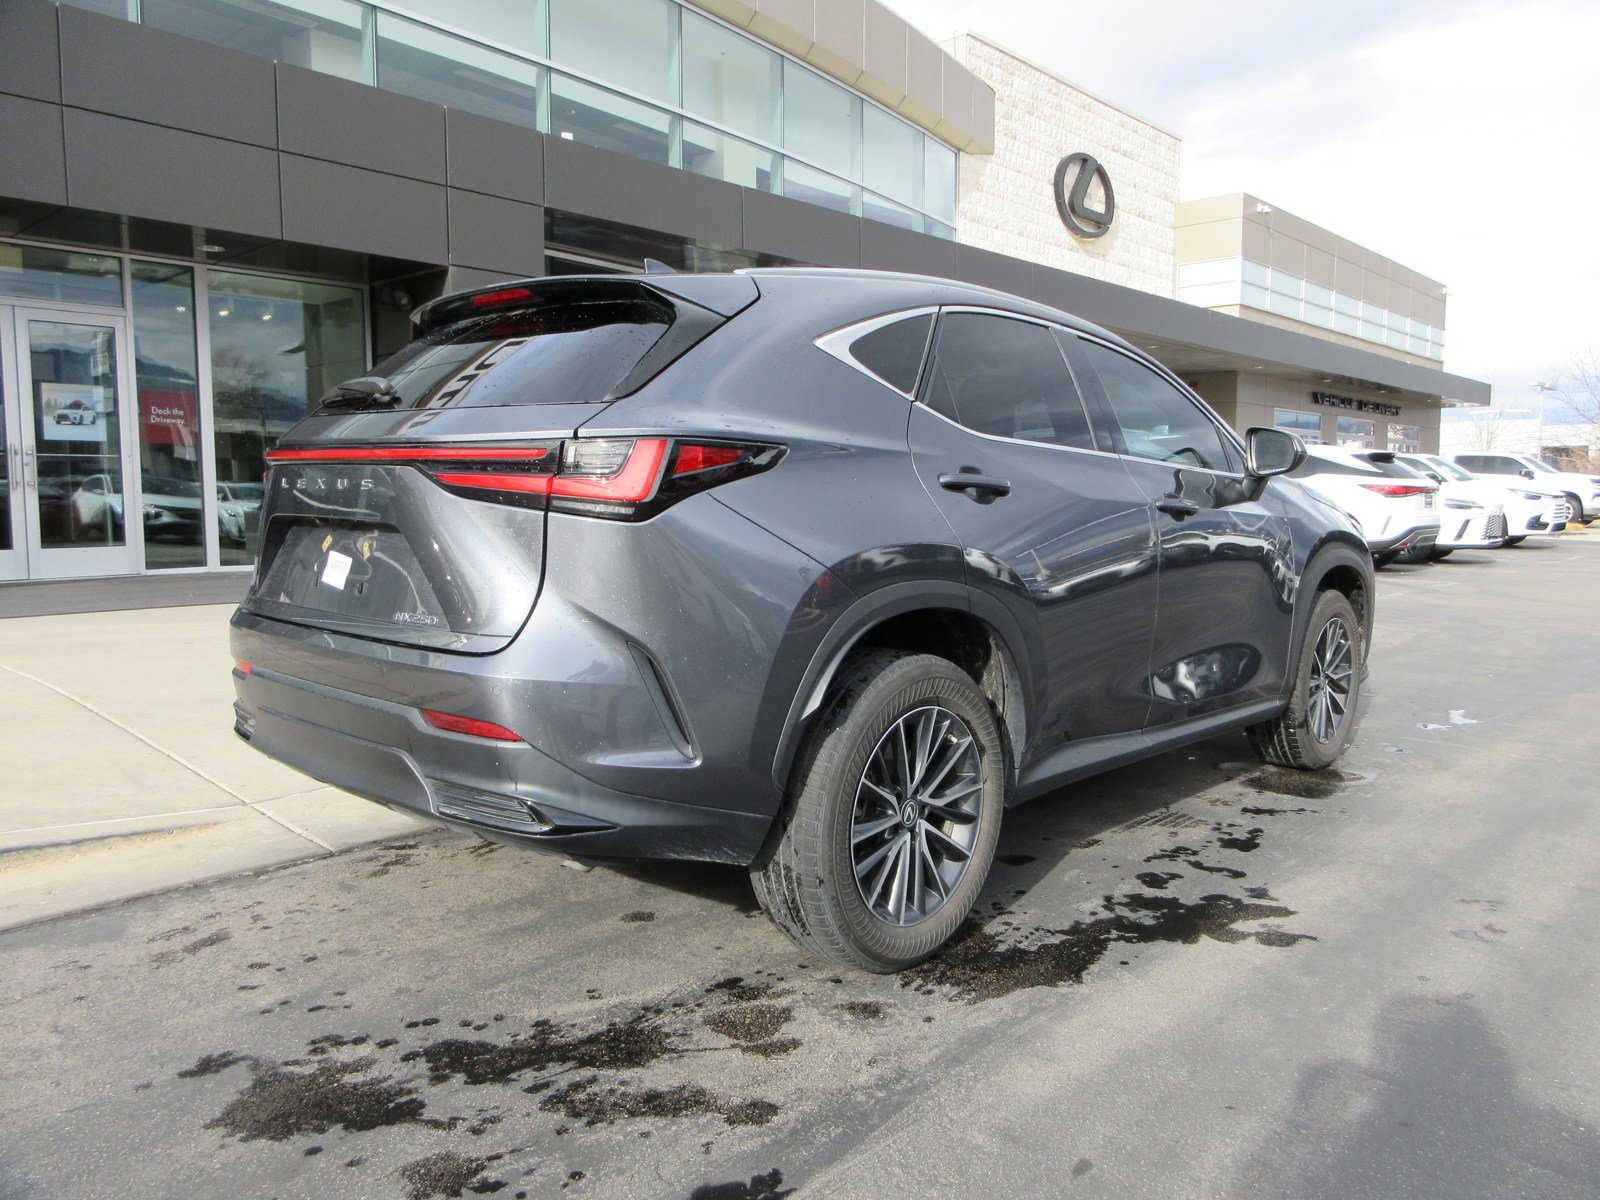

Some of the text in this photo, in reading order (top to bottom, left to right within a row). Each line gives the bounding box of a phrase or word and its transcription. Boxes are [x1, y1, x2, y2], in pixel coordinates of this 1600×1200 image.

[1313, 391, 1401, 416] VEHICLE DELIVERY
[151, 406, 184, 416] Deck the
[281, 477, 374, 490] LEXUS
